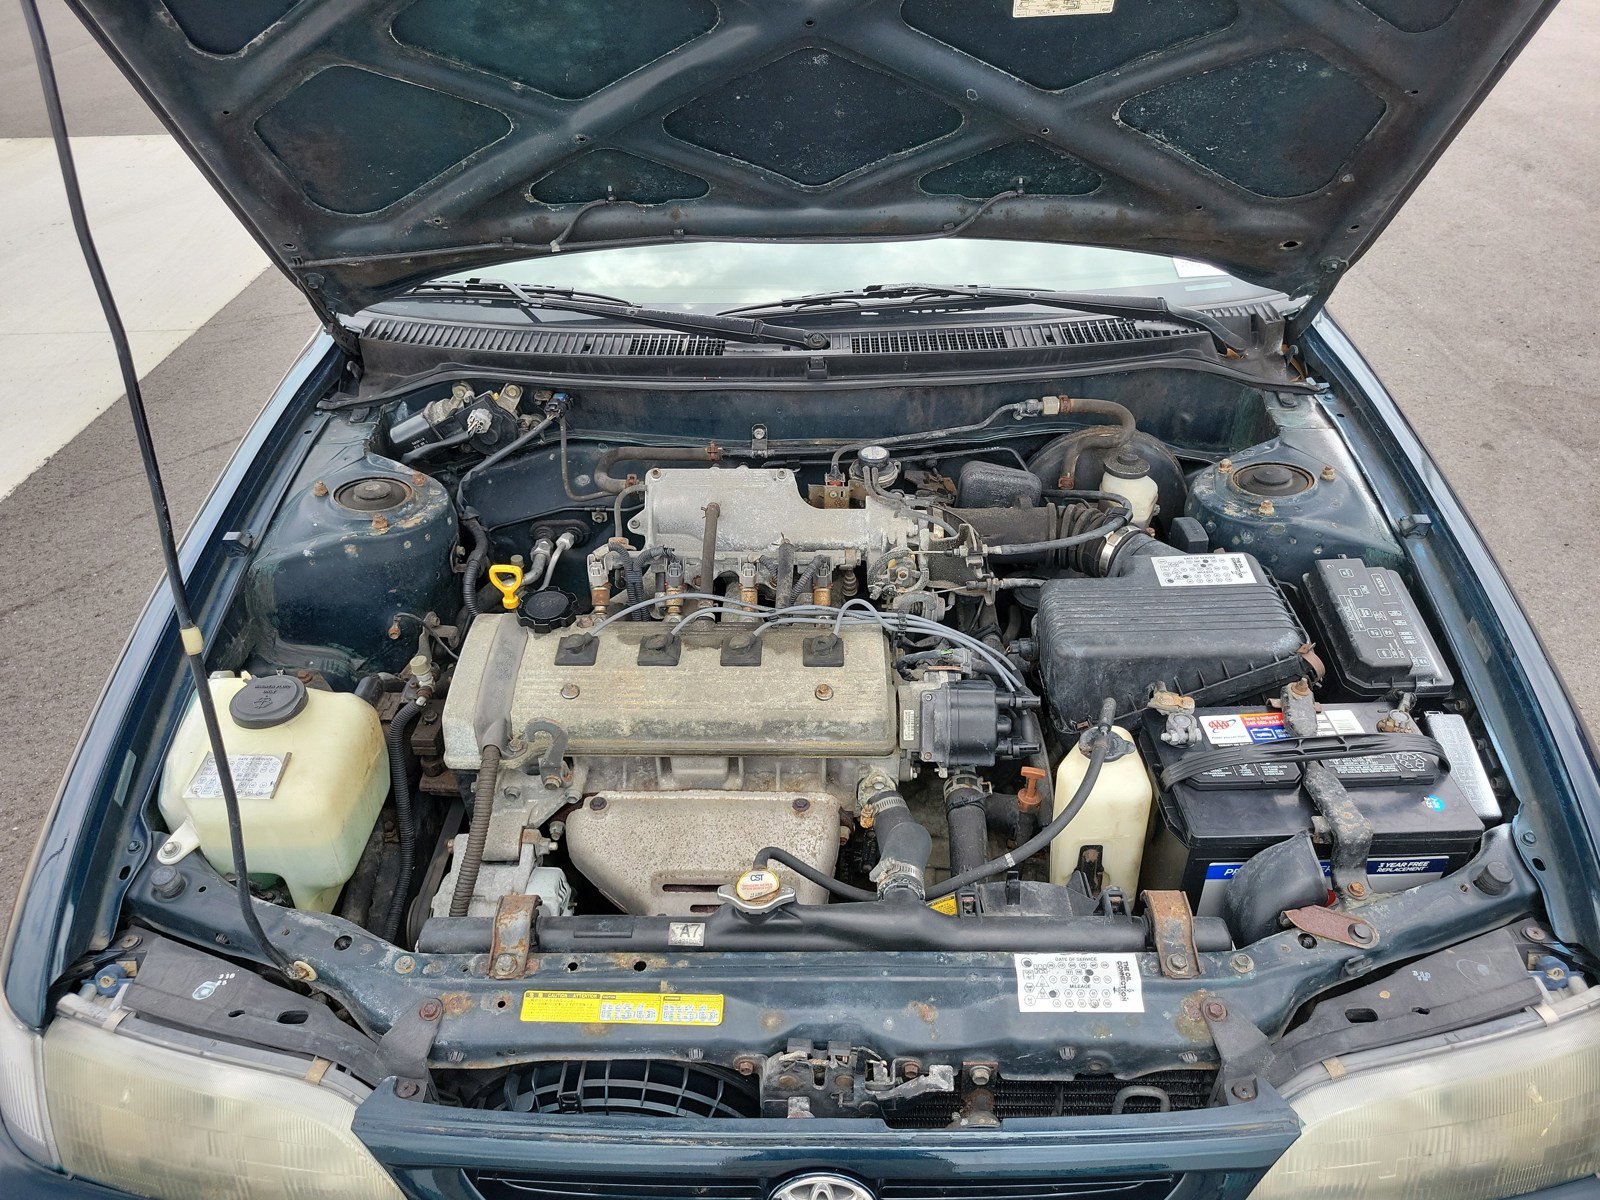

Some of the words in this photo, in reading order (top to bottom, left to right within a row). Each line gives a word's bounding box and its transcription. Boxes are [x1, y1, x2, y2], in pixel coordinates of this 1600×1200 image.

[1208, 720, 1230, 730] AAA
[680, 924, 701, 938] A7
[1116, 960, 1127, 1002] CONNECTION
[1124, 972, 1132, 982] OIL
